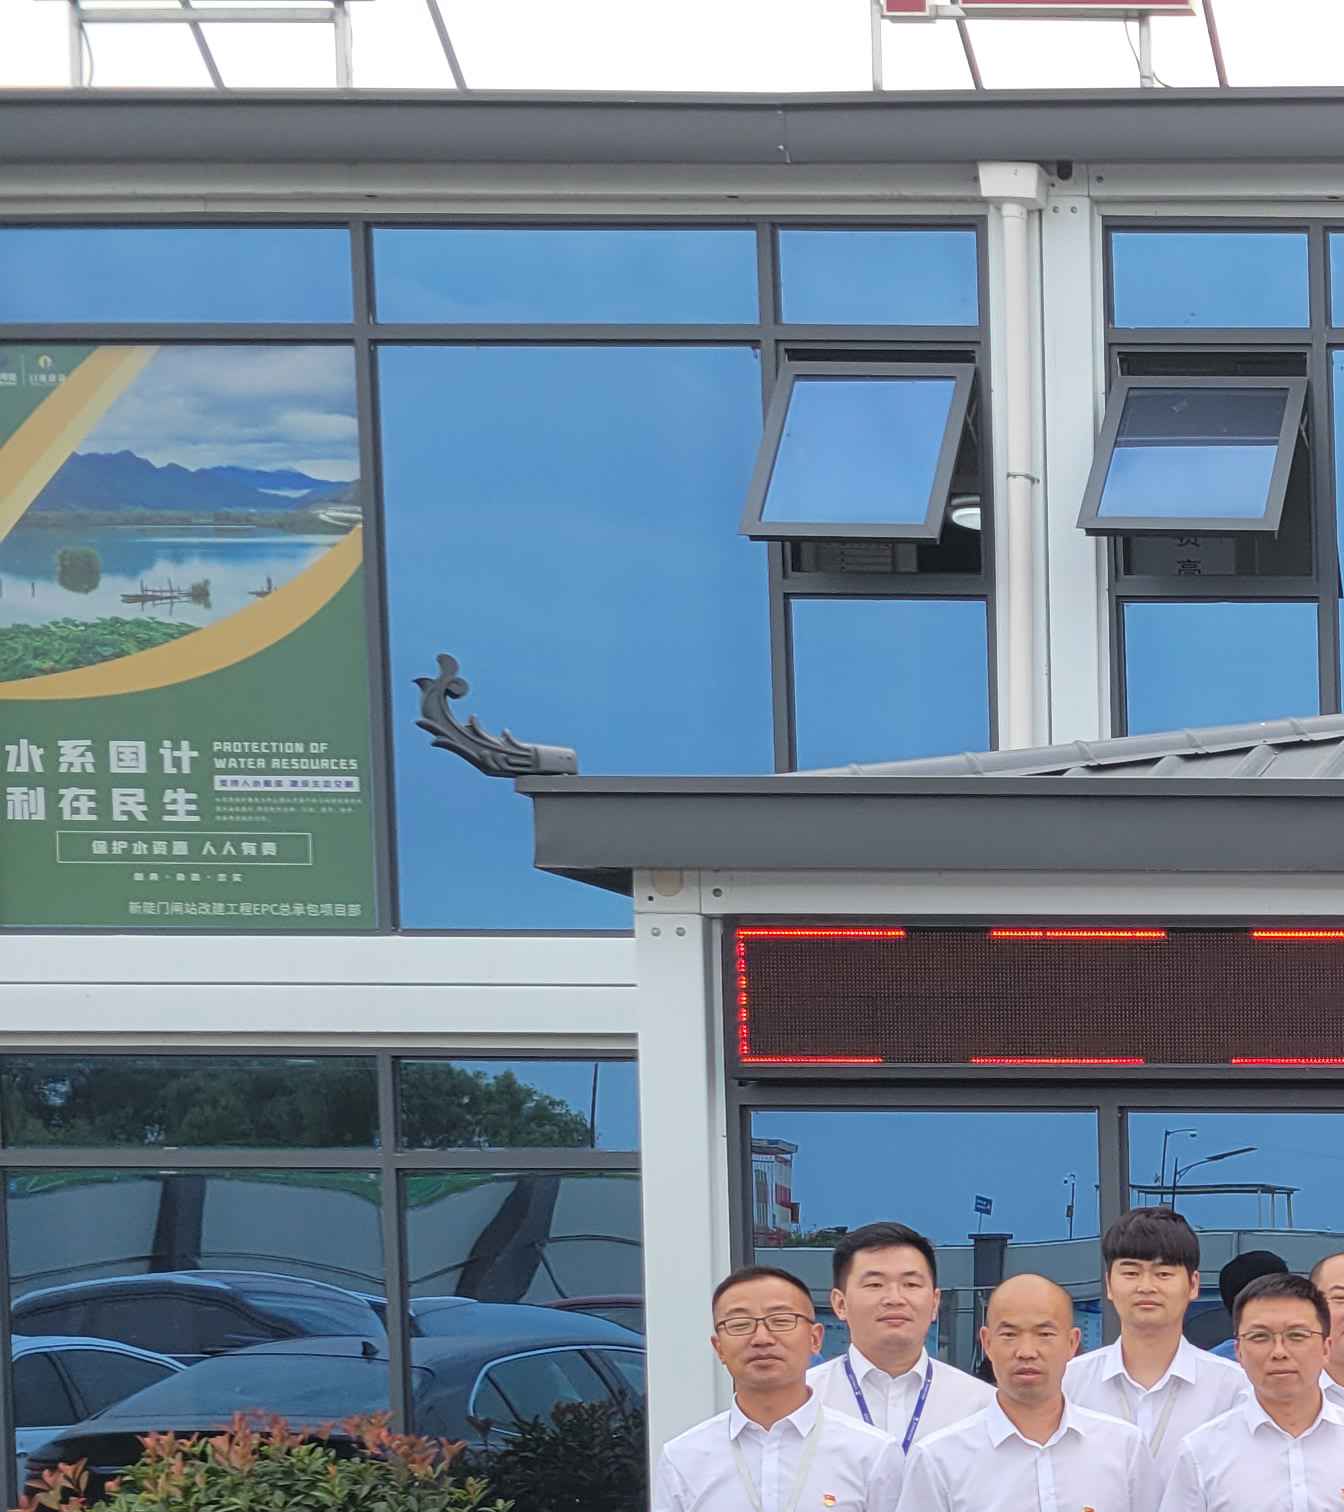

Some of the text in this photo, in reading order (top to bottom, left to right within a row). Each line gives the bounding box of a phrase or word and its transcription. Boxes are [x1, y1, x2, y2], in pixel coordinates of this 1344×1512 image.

[213, 741, 329, 753] PROTECTION OF
[5, 738, 200, 774] 水系国计
[214, 757, 358, 770] WATER RESOURCES
[5, 786, 201, 822] 利在民生
[201, 840, 279, 857] 人人有责
